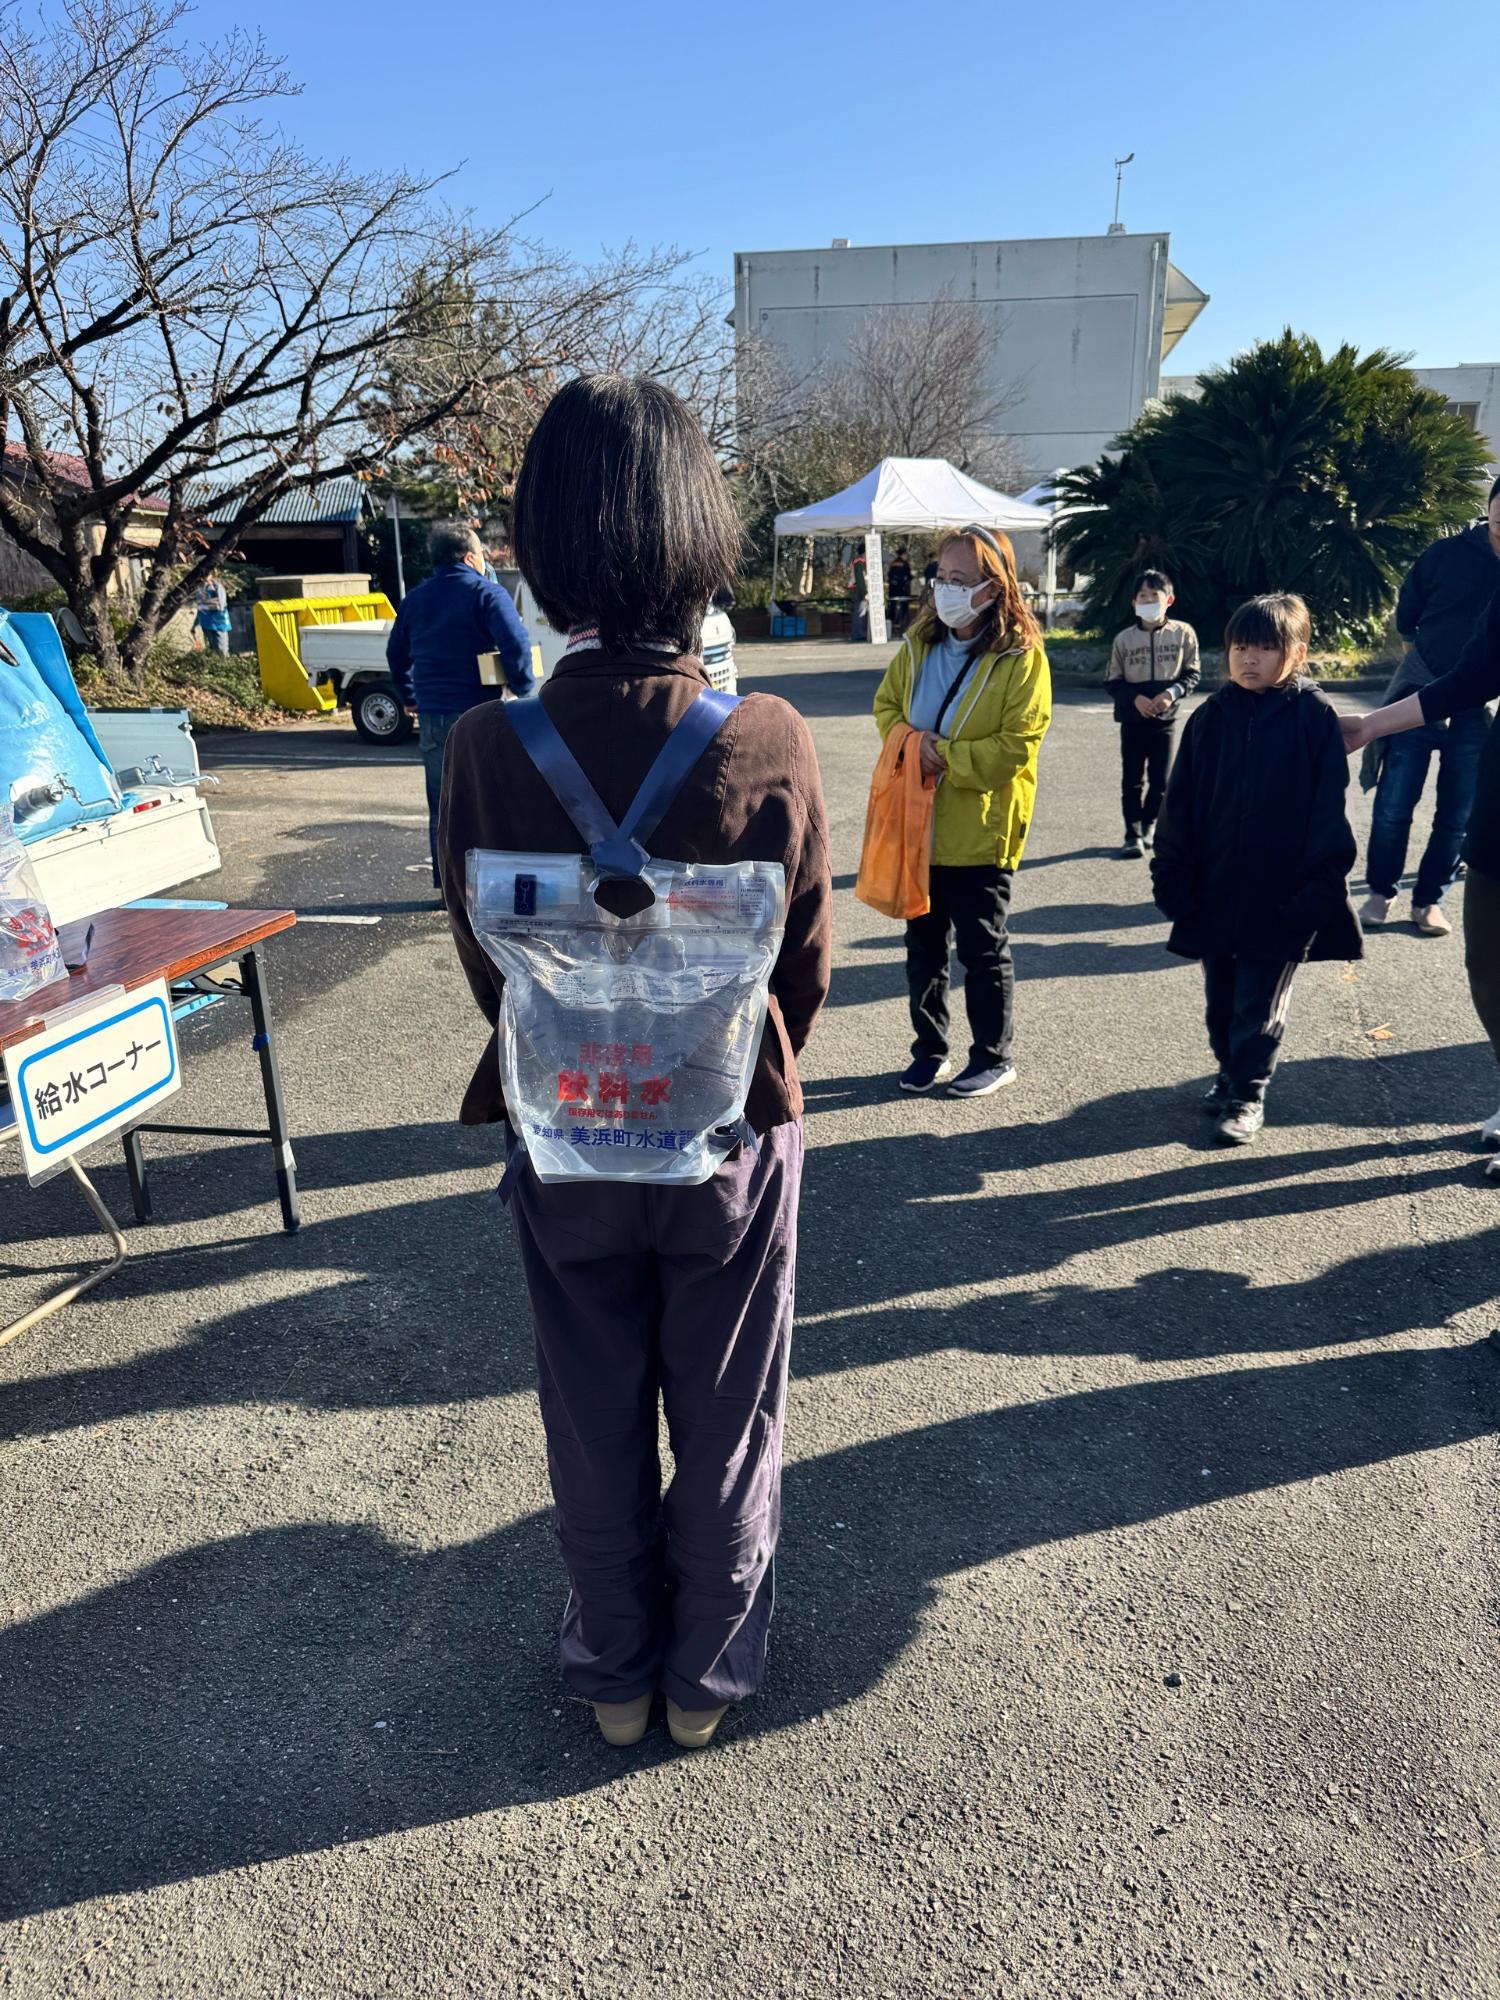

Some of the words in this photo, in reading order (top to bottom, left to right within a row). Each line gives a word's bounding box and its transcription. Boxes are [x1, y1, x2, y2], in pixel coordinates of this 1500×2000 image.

[34, 1040, 161, 1120] 給水コーナー
[557, 1068, 672, 1105] 飲料水
[568, 1107, 657, 1121] 保存用ではありません
[532, 1124, 565, 1140] 愛知県
